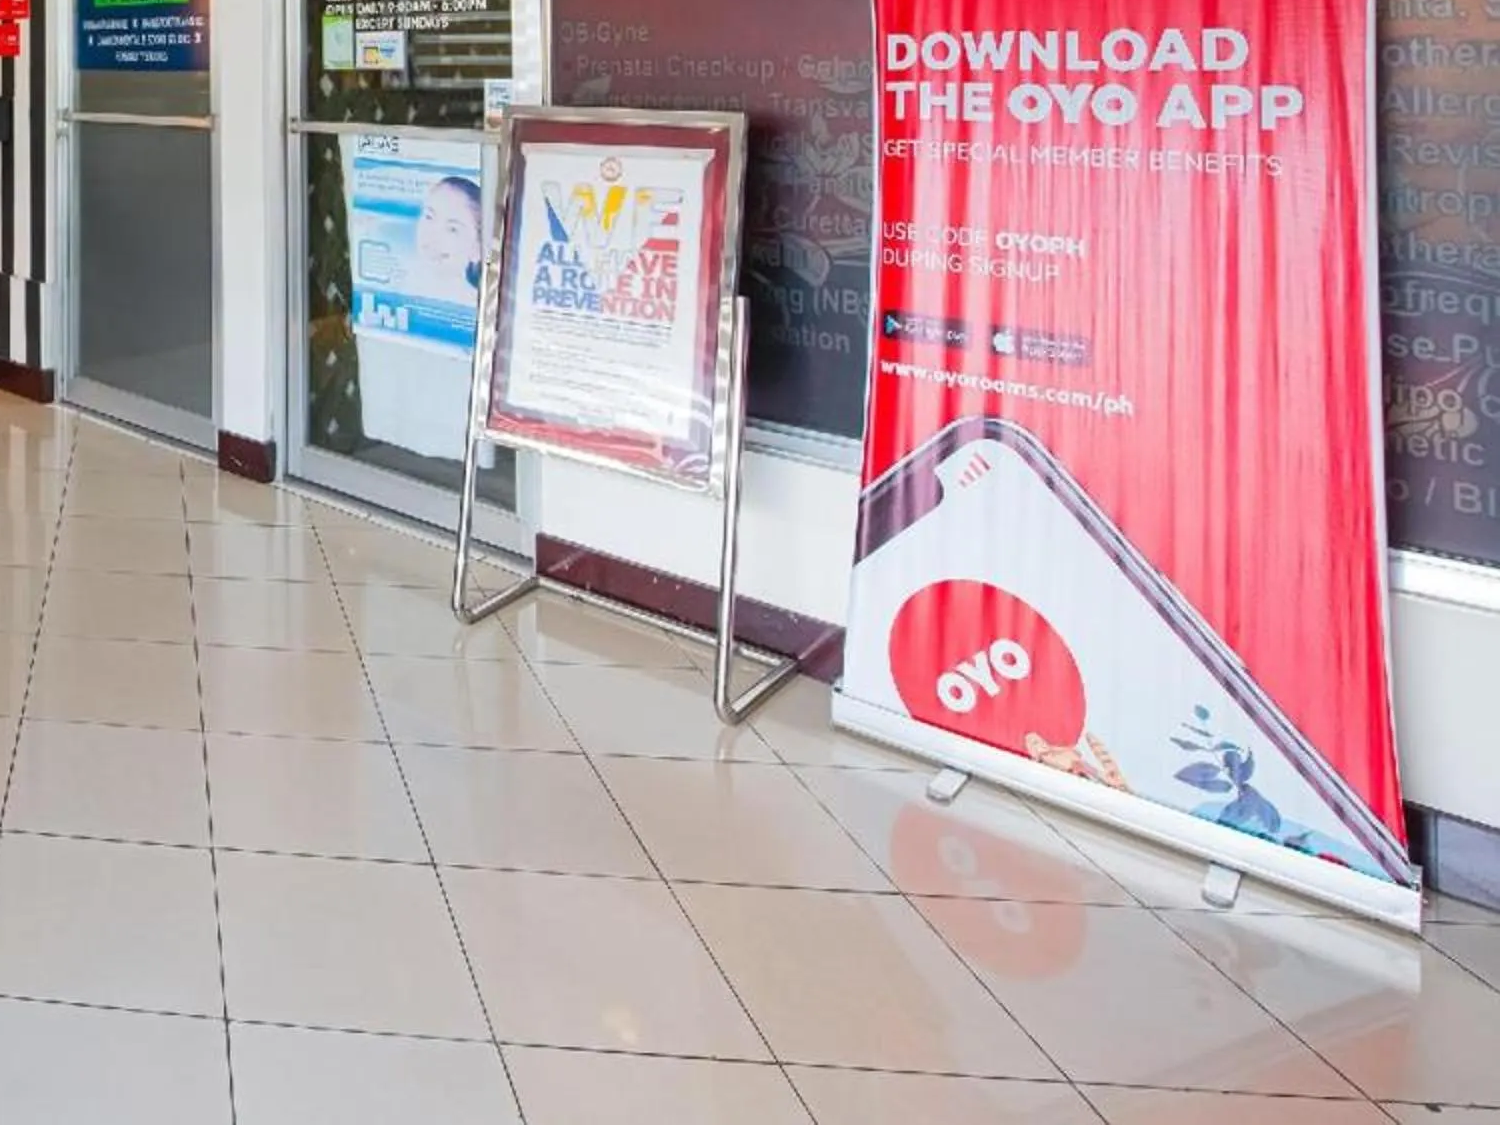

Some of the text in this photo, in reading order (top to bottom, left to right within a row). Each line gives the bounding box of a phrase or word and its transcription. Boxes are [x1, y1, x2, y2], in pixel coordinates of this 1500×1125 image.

[356, 1, 384, 15] DAILY
[356, 15, 450, 31] EXCEPT SUNDAYS
[886, 27, 1250, 74] DOWNLOAD
[577, 54, 659, 77] Prenatal
[666, 52, 775, 87] Check-up
[885, 81, 1305, 131] THE OYO APP
[883, 138, 926, 160] GET
[929, 140, 1021, 165] SPECIAL
[1030, 144, 1140, 172] MEMBER
[1149, 150, 1283, 177] BENEFITS
[537, 242, 584, 267] ALL
[883, 221, 1087, 258] USE CODE OYOPH
[534, 265, 551, 285] A
[641, 276, 678, 303] IN
[967, 254, 1061, 282] SIGNUP
[532, 286, 677, 323] PREVENTION
[880, 359, 1135, 417] www.oyorooms.com/ph
[936, 638, 1032, 713] OYO
